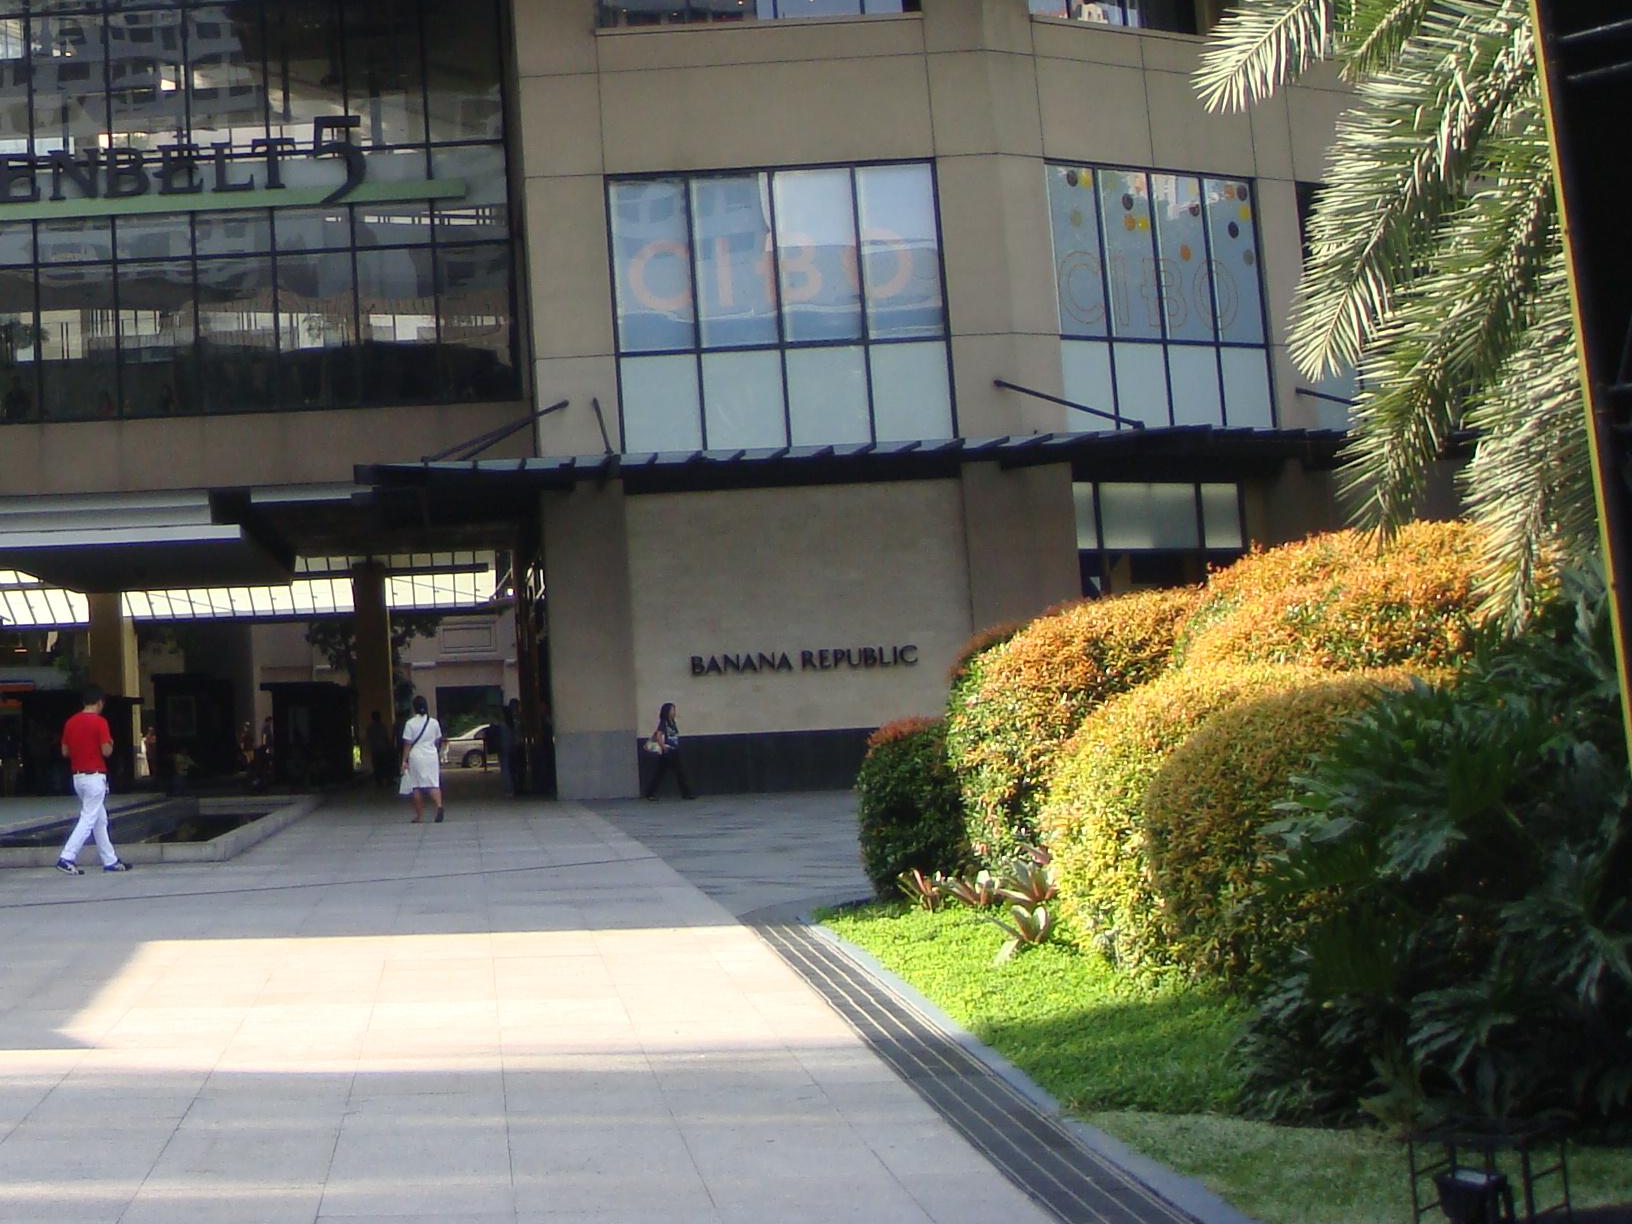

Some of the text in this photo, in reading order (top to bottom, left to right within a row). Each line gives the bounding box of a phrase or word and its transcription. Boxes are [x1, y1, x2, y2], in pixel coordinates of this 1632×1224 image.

[313, 114, 367, 205] 5
[628, 227, 914, 311] CIBO
[1058, 250, 1239, 330] CIBO
[690, 644, 919, 676] BANANA REPUBLIC
